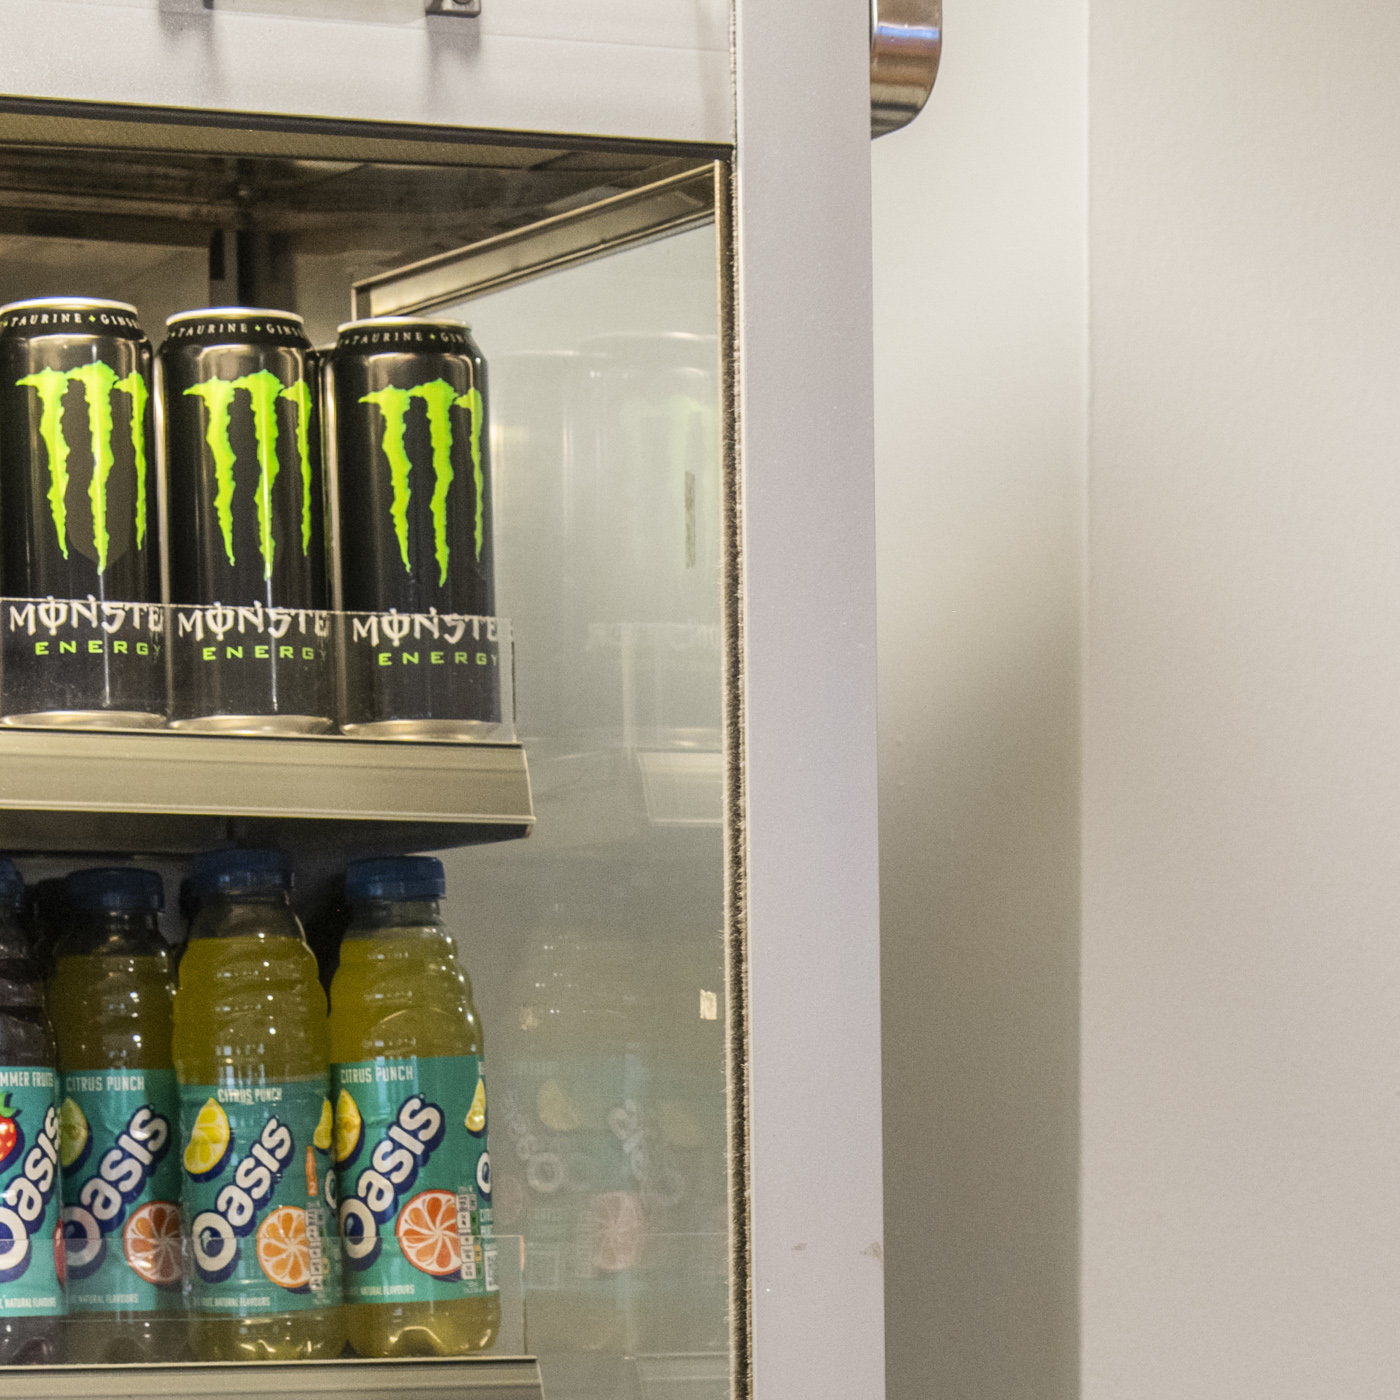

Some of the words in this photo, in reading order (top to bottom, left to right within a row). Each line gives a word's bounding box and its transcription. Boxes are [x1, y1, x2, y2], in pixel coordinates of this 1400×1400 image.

[11, 312, 82, 328] TAURINE
[177, 322, 248, 338] TAURINE
[9, 594, 164, 636] MONSTE
[177, 600, 331, 642] MONSTE
[35, 640, 161, 657] ENERGY
[378, 651, 497, 666] ENERGY
[340, 1068, 372, 1084] CITRUS
[375, 1066, 414, 1082] PUNCH
[66, 1076, 102, 1092] CITRUS
[107, 1076, 145, 1091] PUNCH
[217, 1088, 253, 1102] CITRUS
[254, 1087, 282, 1102] PUNCH
[341, 1097, 441, 1259] Oasis
[62, 1107, 168, 1267] Oasis
[192, 1117, 292, 1272] Oasis
